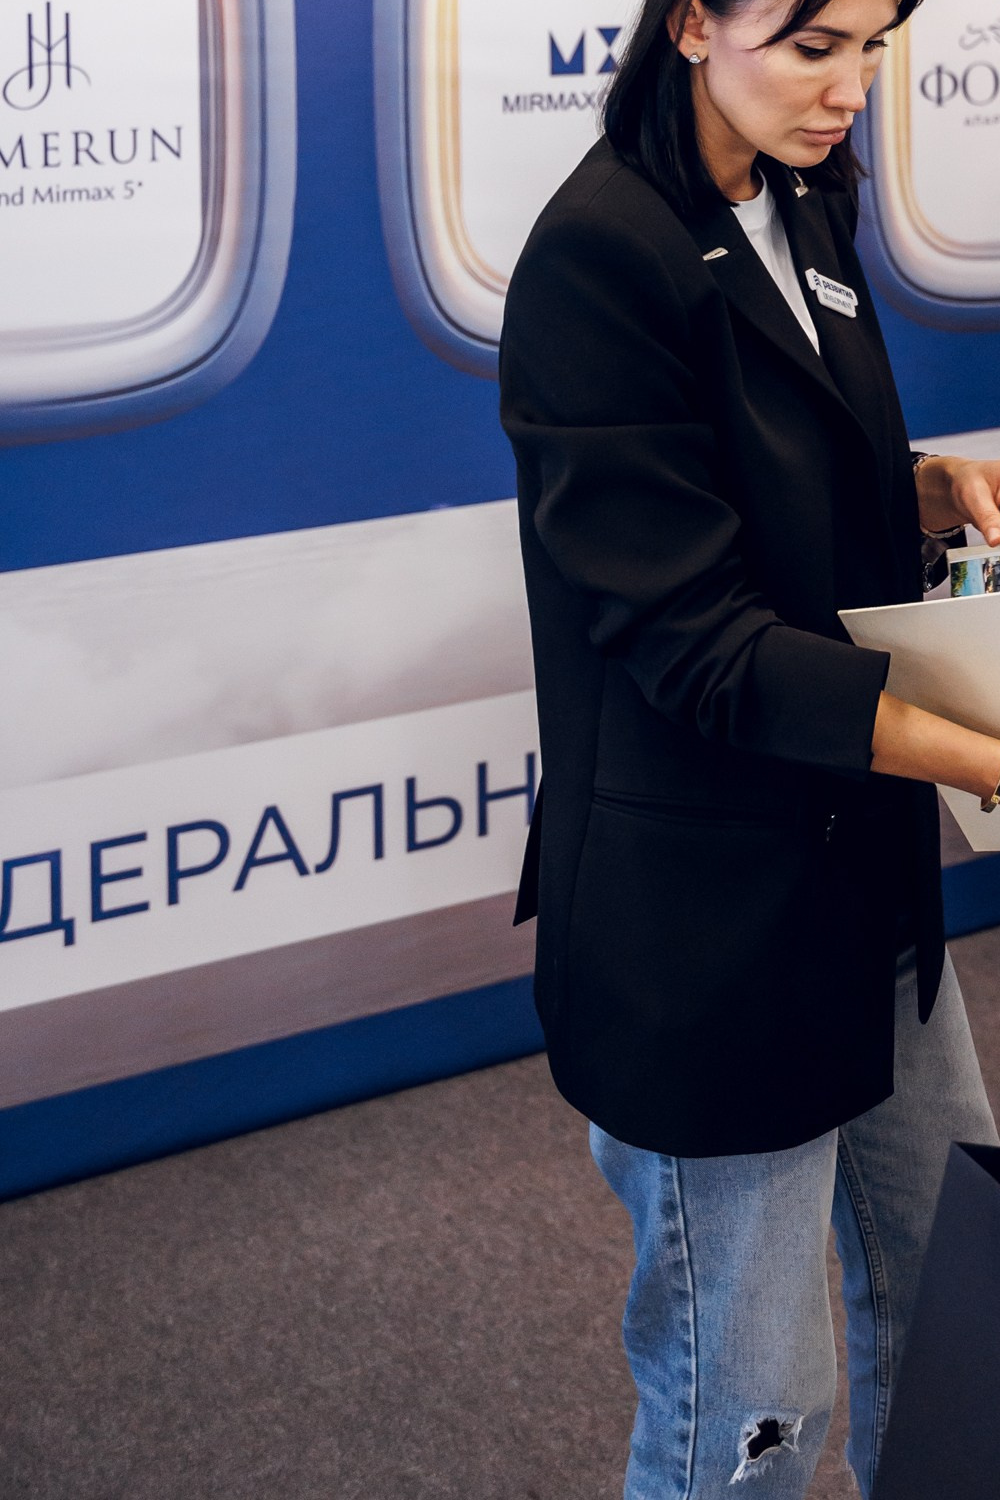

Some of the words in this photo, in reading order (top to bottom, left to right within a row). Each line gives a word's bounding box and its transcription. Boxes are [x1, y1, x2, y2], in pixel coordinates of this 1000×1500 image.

[502, 92, 596, 114] MIRMAX
[32, 184, 116, 205] Mirmax
[0, 752, 536, 947] ДЕРАЛЬН
